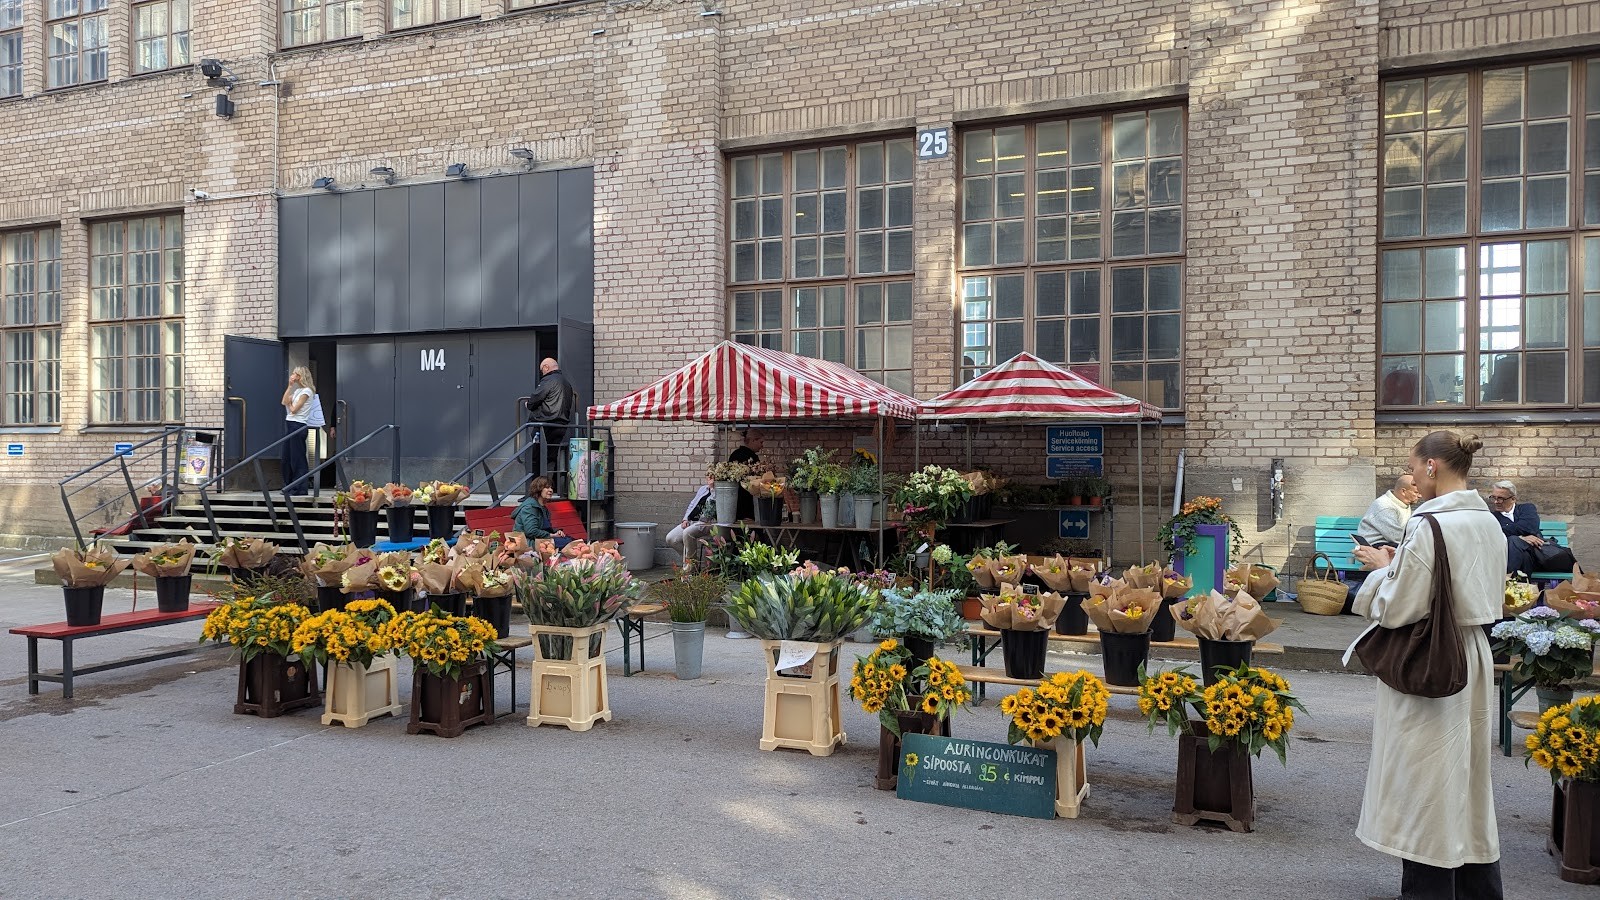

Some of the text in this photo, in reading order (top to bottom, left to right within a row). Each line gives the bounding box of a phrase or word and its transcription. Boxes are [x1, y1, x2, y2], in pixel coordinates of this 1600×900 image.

[920, 131, 948, 157] 25
[420, 348, 446, 371] M4
[1051, 437, 1098, 445] Servicekörning
[943, 742, 1048, 767] AURINGONKUKAT
[922, 754, 972, 775] SIPOOSTA
[1013, 771, 1045, 786] KIMPPU
